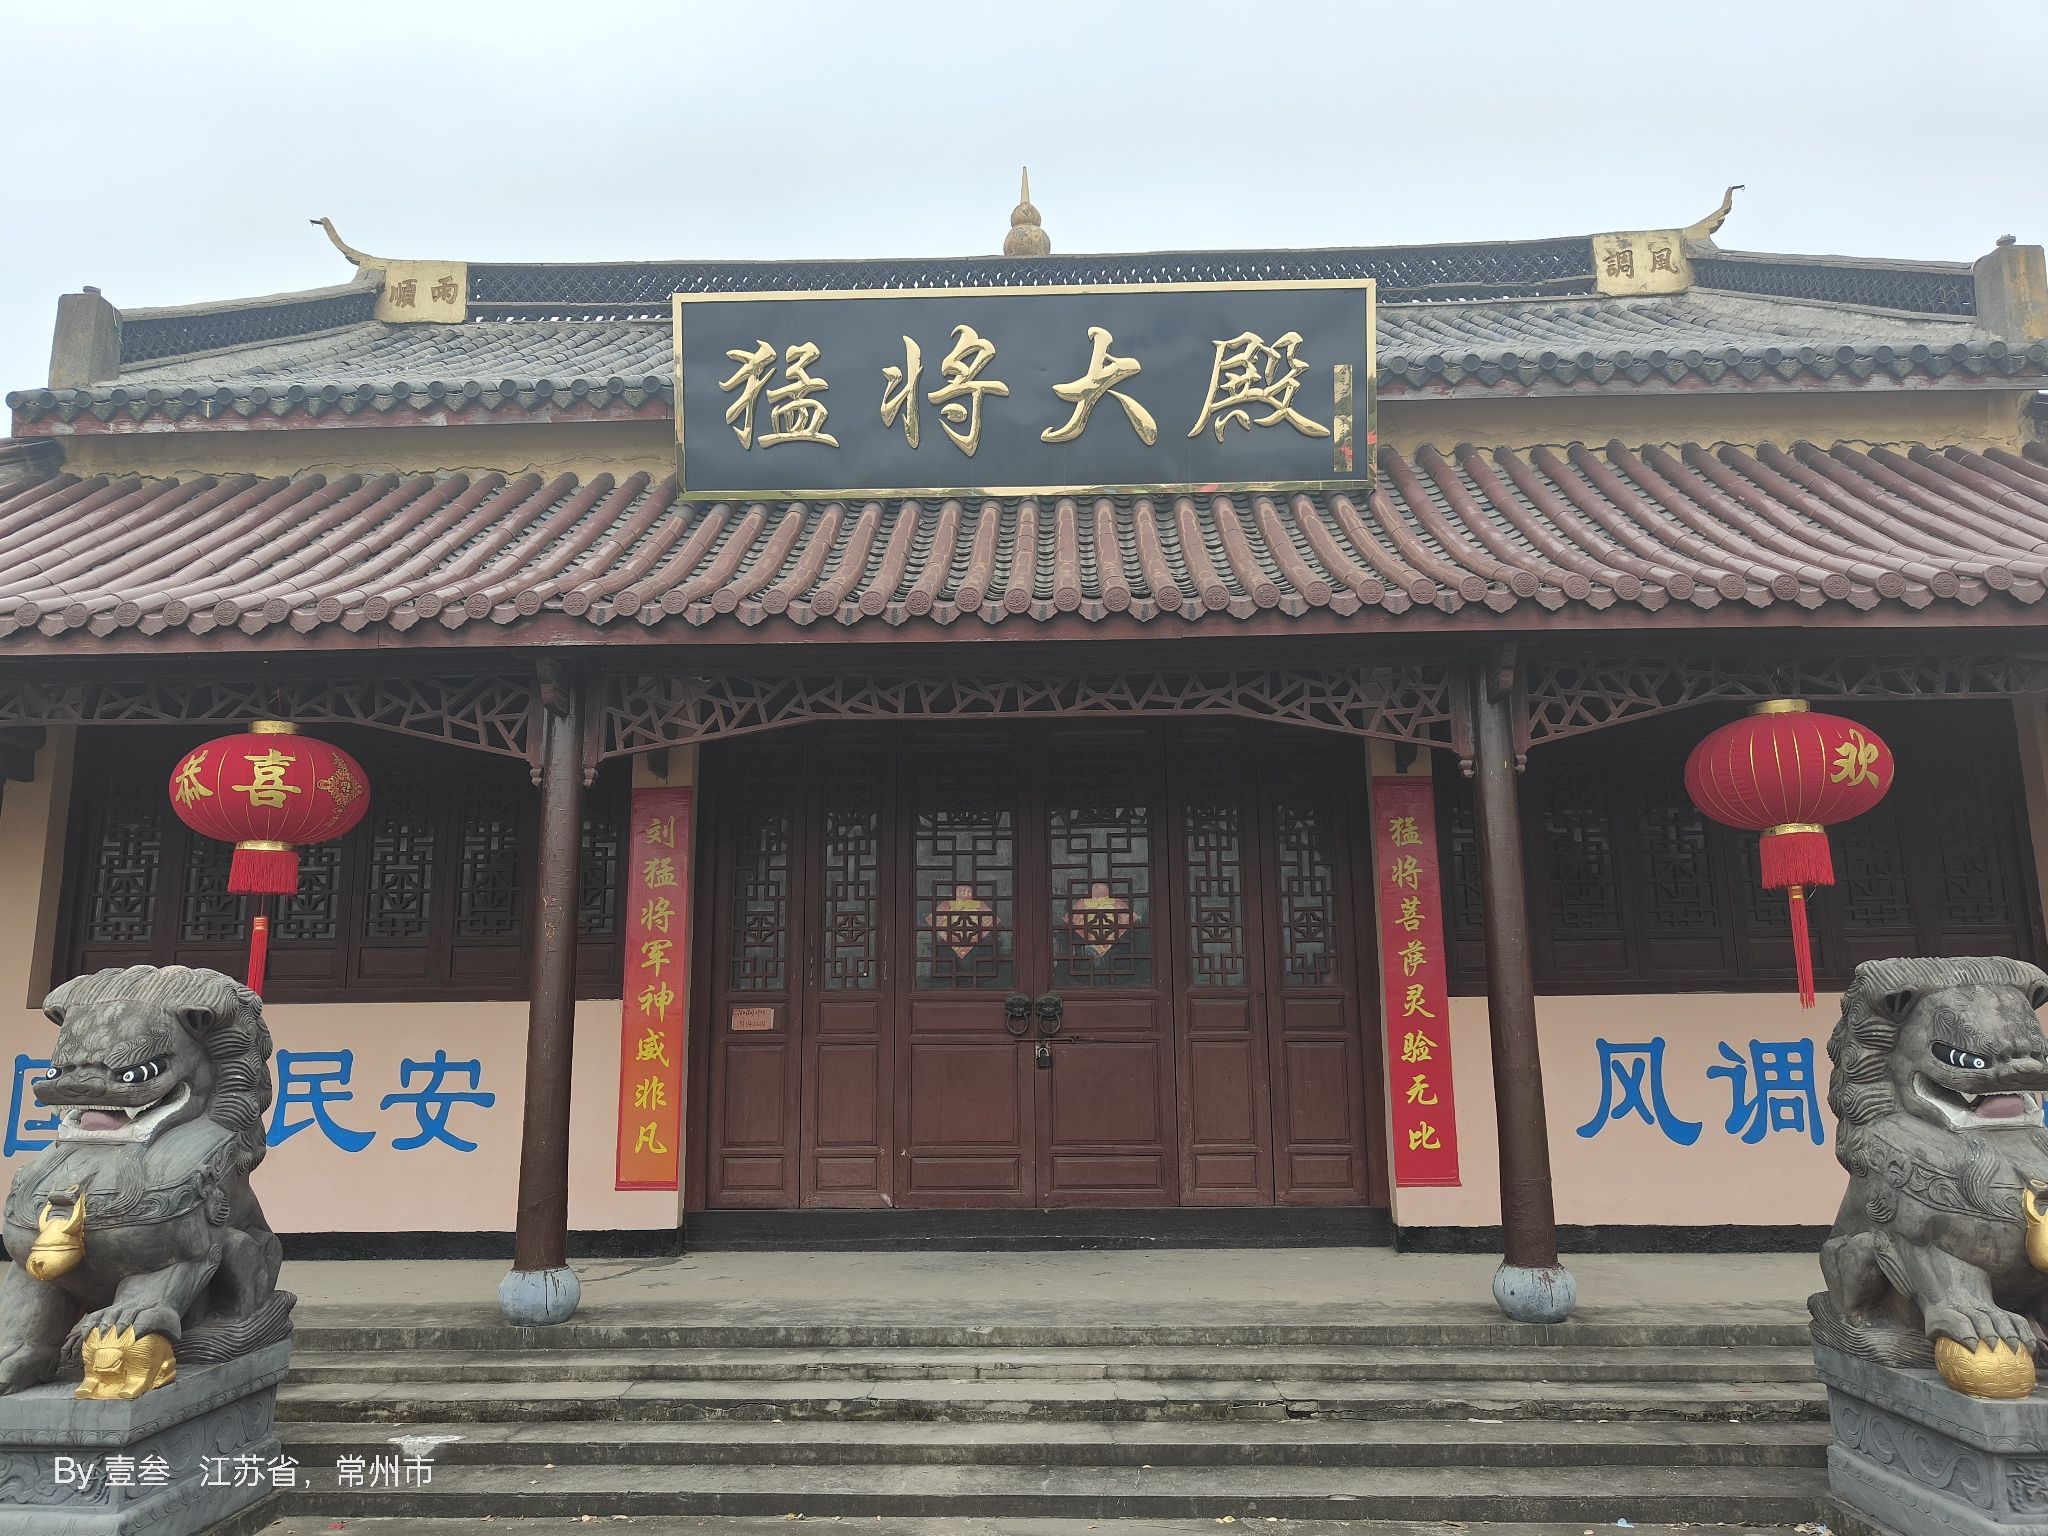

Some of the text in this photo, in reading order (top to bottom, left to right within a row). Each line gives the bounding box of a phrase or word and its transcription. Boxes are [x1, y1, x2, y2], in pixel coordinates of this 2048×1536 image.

[1389, 816, 1442, 1151] 猛将菩萨灵验无比
